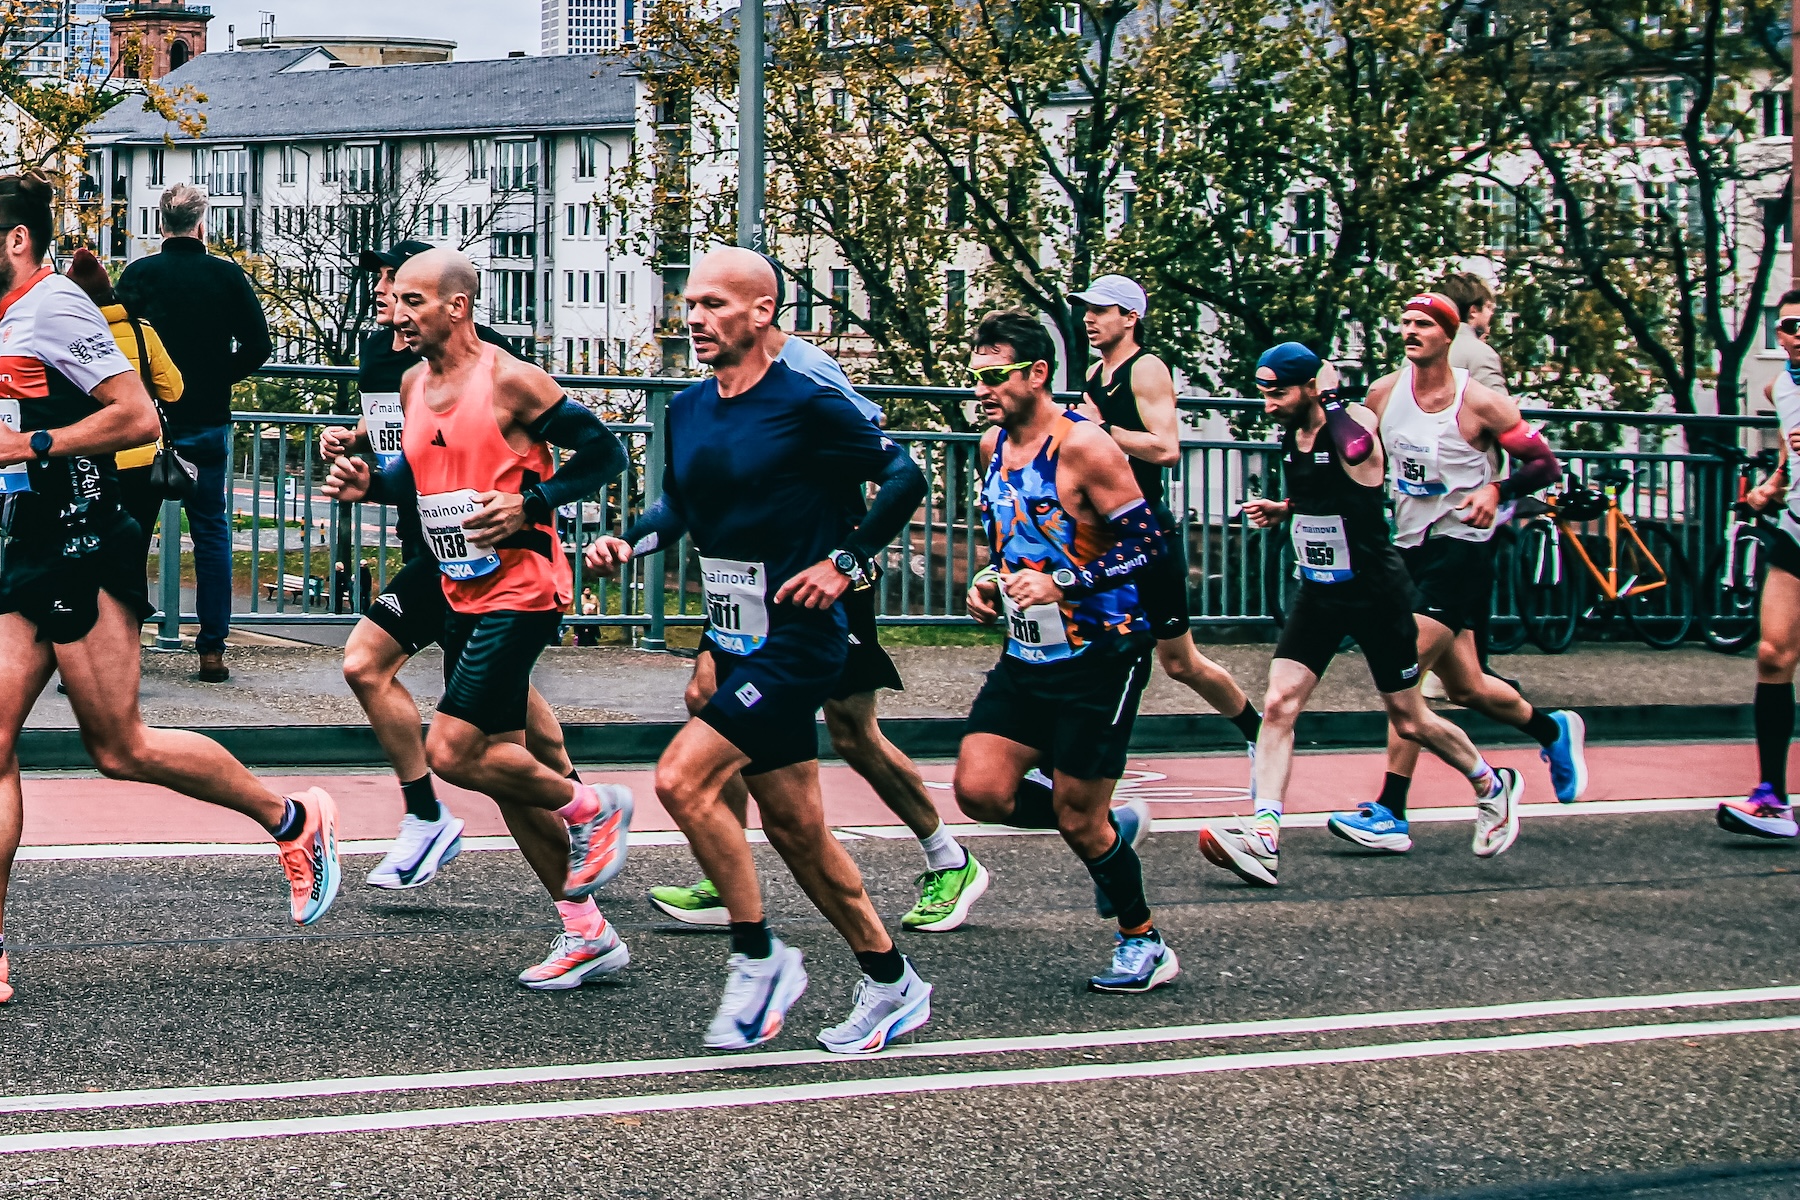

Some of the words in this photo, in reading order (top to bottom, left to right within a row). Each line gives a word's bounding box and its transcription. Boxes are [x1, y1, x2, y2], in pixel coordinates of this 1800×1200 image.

[379, 402, 402, 413] main
[422, 503, 474, 518] mainova
[430, 533, 468, 559] 7138
[310, 844, 324, 902] BROOKS
